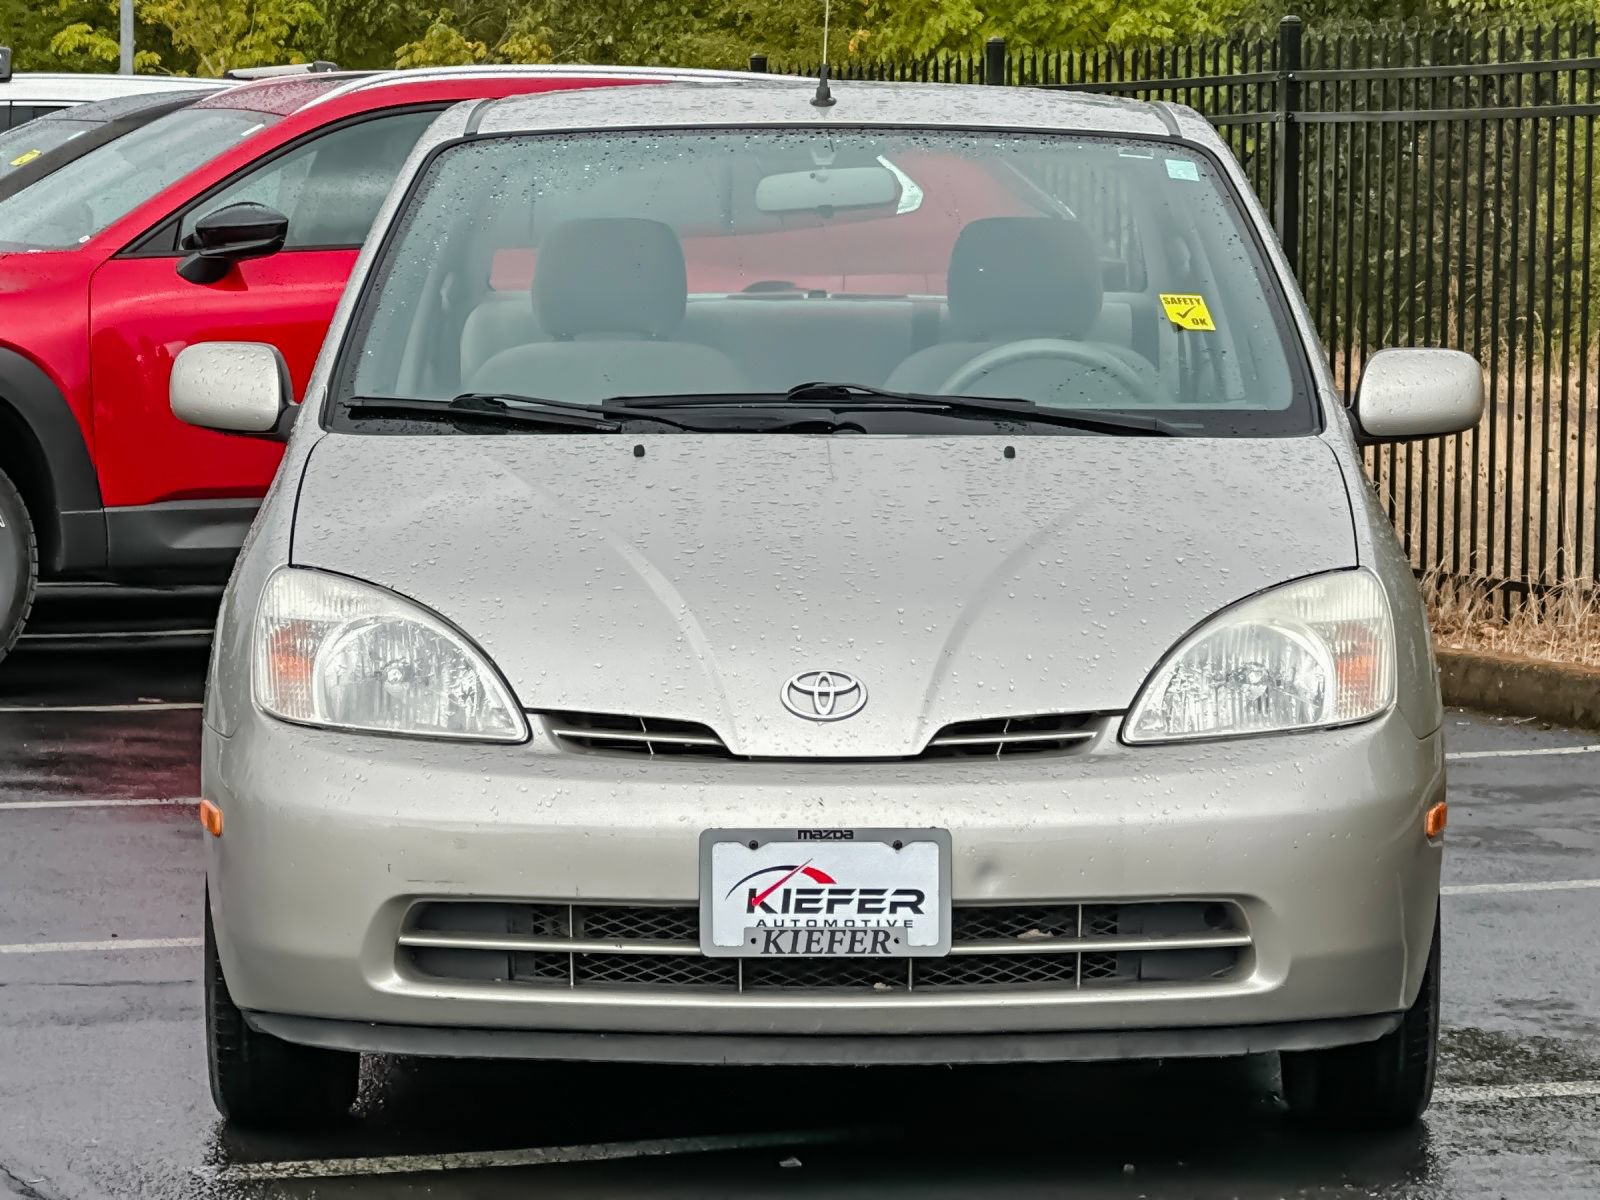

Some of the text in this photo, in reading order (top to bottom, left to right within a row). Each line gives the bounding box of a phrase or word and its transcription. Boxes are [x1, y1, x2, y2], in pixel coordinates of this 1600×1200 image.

[1162, 297, 1201, 305] SAFETY
[1191, 317, 1208, 326] OK
[798, 829, 854, 840] mazda
[746, 888, 925, 915] KIEFER
[756, 919, 914, 928] AUTOMOTIVE
[760, 929, 892, 954] KIEFER
